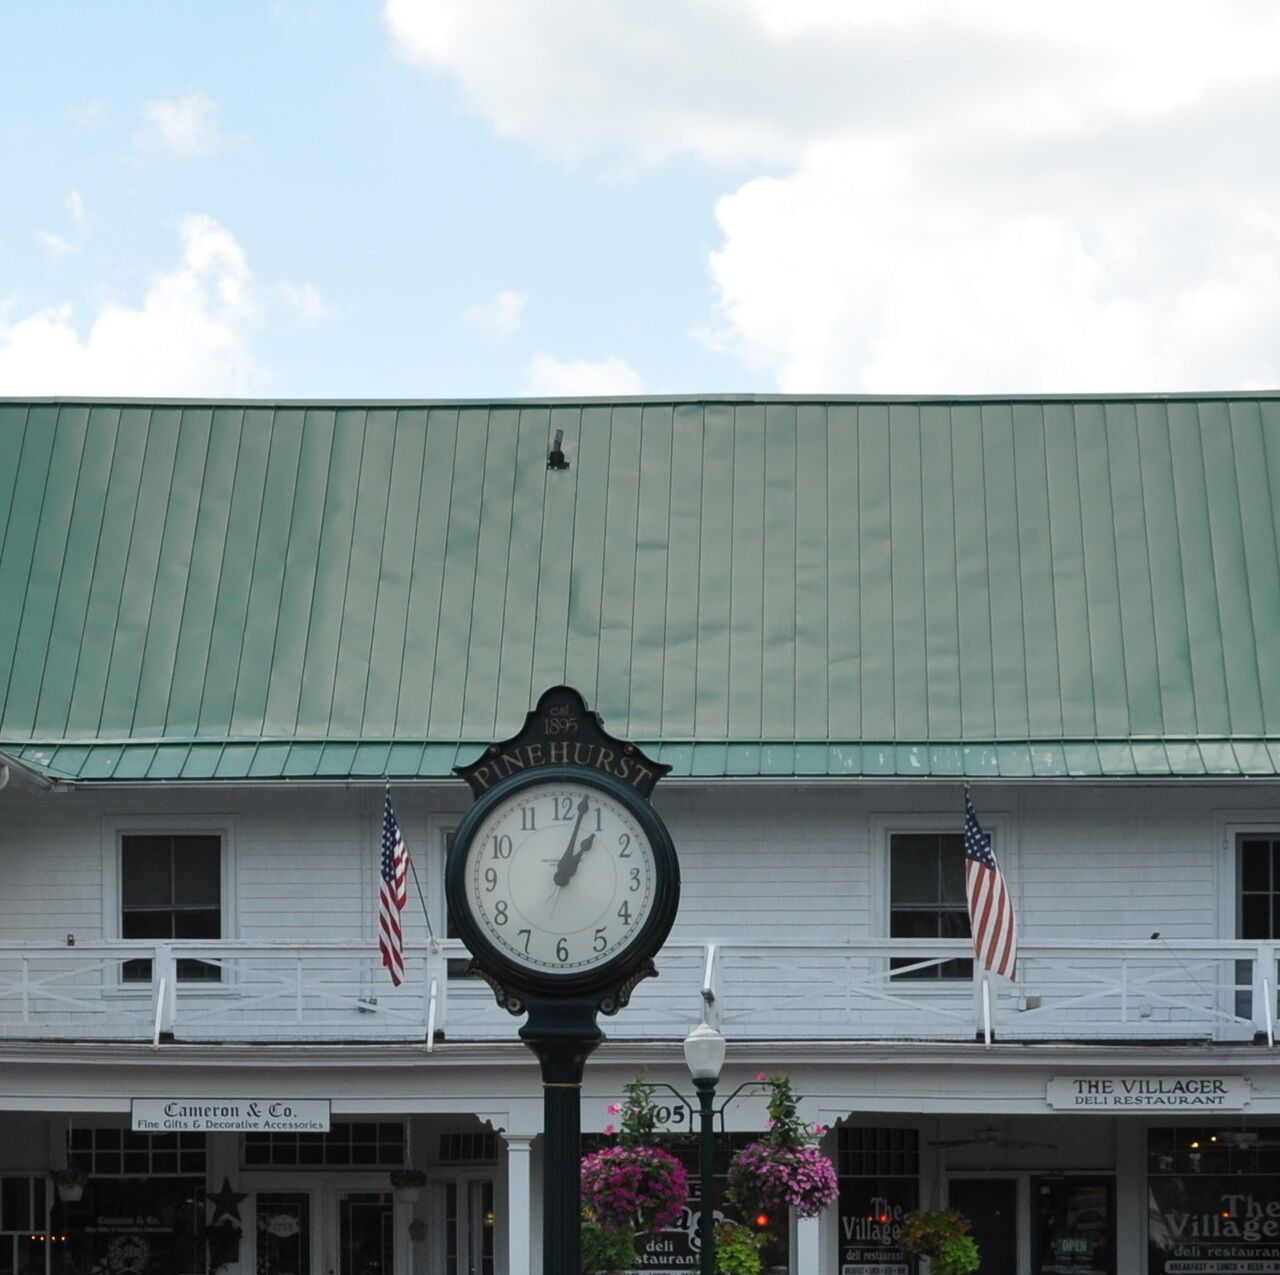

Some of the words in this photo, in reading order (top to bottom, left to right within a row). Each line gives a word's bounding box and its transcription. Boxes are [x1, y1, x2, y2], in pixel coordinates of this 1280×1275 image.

[544, 717, 579, 735] 1895
[472, 741, 654, 789] PINEHURST
[520, 807, 536, 831] 11
[551, 797, 575, 820] 12
[594, 808, 604, 832] 1
[491, 835, 513, 859] 10
[619, 834, 631, 858] 2
[484, 868, 498, 892] 9
[629, 869, 641, 892] 3
[494, 900, 508, 926] 8
[617, 900, 632, 925] 4
[517, 930, 532, 955] 7
[556, 937, 569, 962] 6
[593, 927, 608, 953] 5
[1073, 1079, 1114, 1094] THE
[1120, 1079, 1229, 1094] VILLAGER
[163, 1102, 239, 1118] Cameron
[246, 1103, 261, 1118] &
[268, 1102, 297, 1118] Co.
[1074, 1095, 1108, 1105] DELI
[1113, 1095, 1225, 1105] RESTAURANT
[137, 1120, 160, 1129] Fine
[163, 1120, 188, 1129] Gifts
[192, 1120, 200, 1129] &
[205, 1120, 259, 1129] Decorative
[263, 1120, 324, 1129] Accessories
[870, 1197, 902, 1221] The
[842, 1216, 902, 1245] Village
[645, 1240, 674, 1252] deli
[1174, 1246, 1200, 1257] deli
